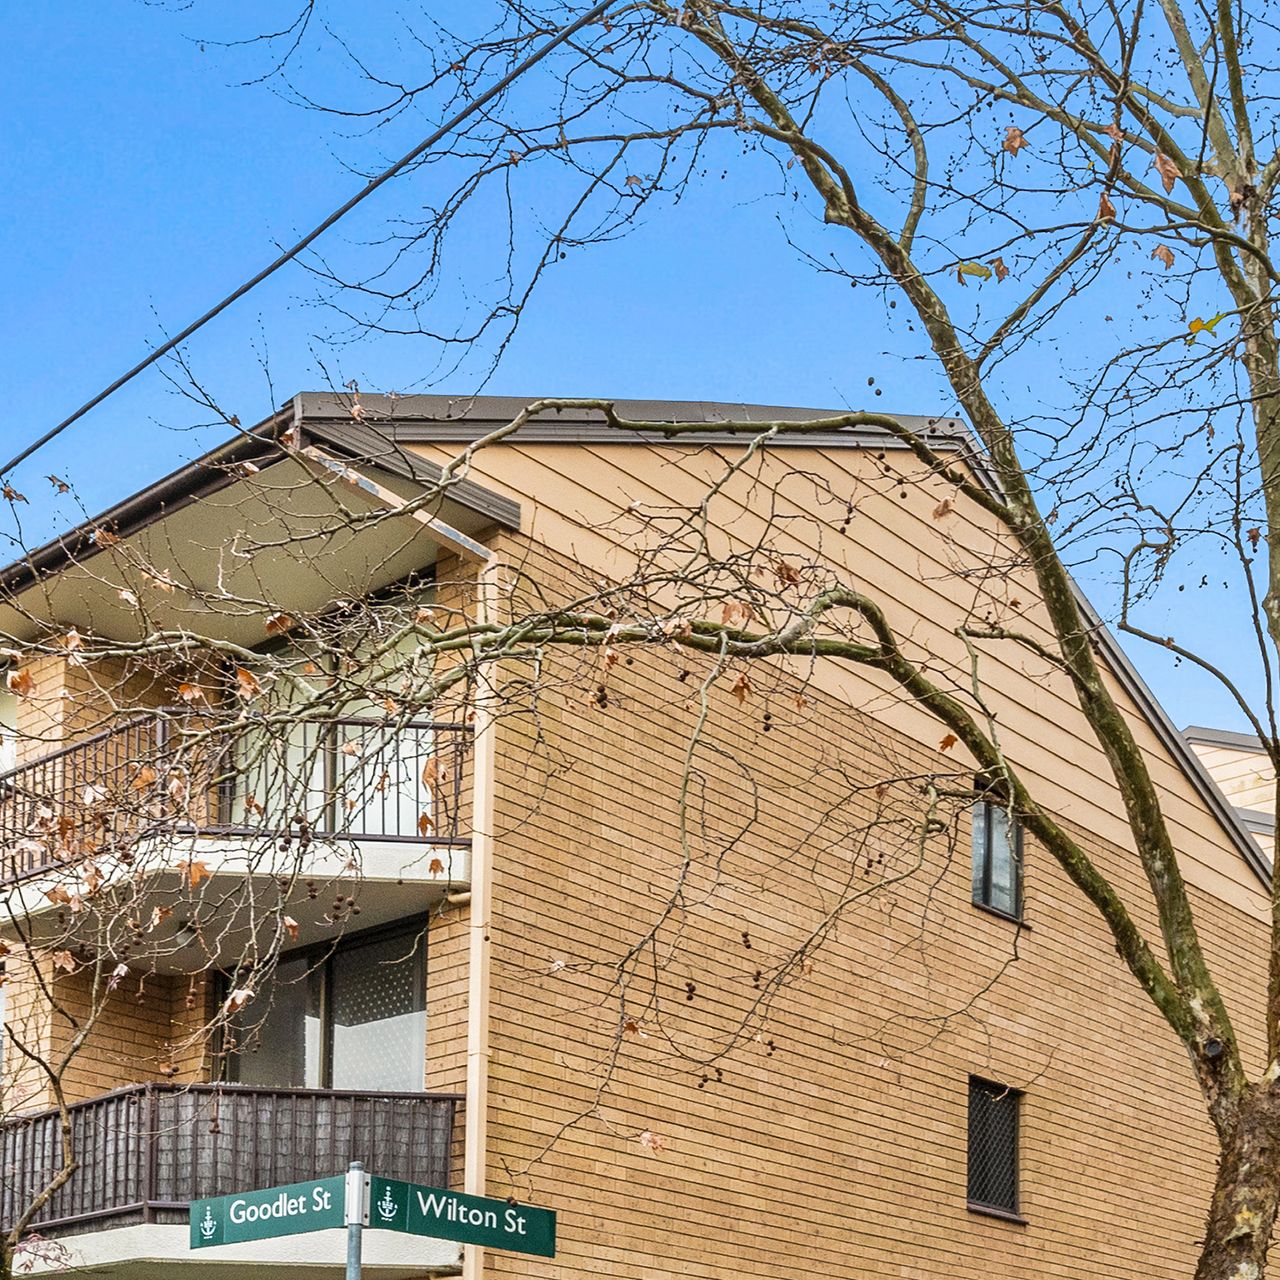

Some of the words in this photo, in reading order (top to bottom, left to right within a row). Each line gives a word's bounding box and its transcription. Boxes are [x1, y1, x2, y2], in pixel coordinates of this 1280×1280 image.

[230, 1193, 307, 1224] Goodlet
[312, 1187, 332, 1211] St
[416, 1191, 497, 1229] Wilton
[504, 1209, 526, 1235] St
